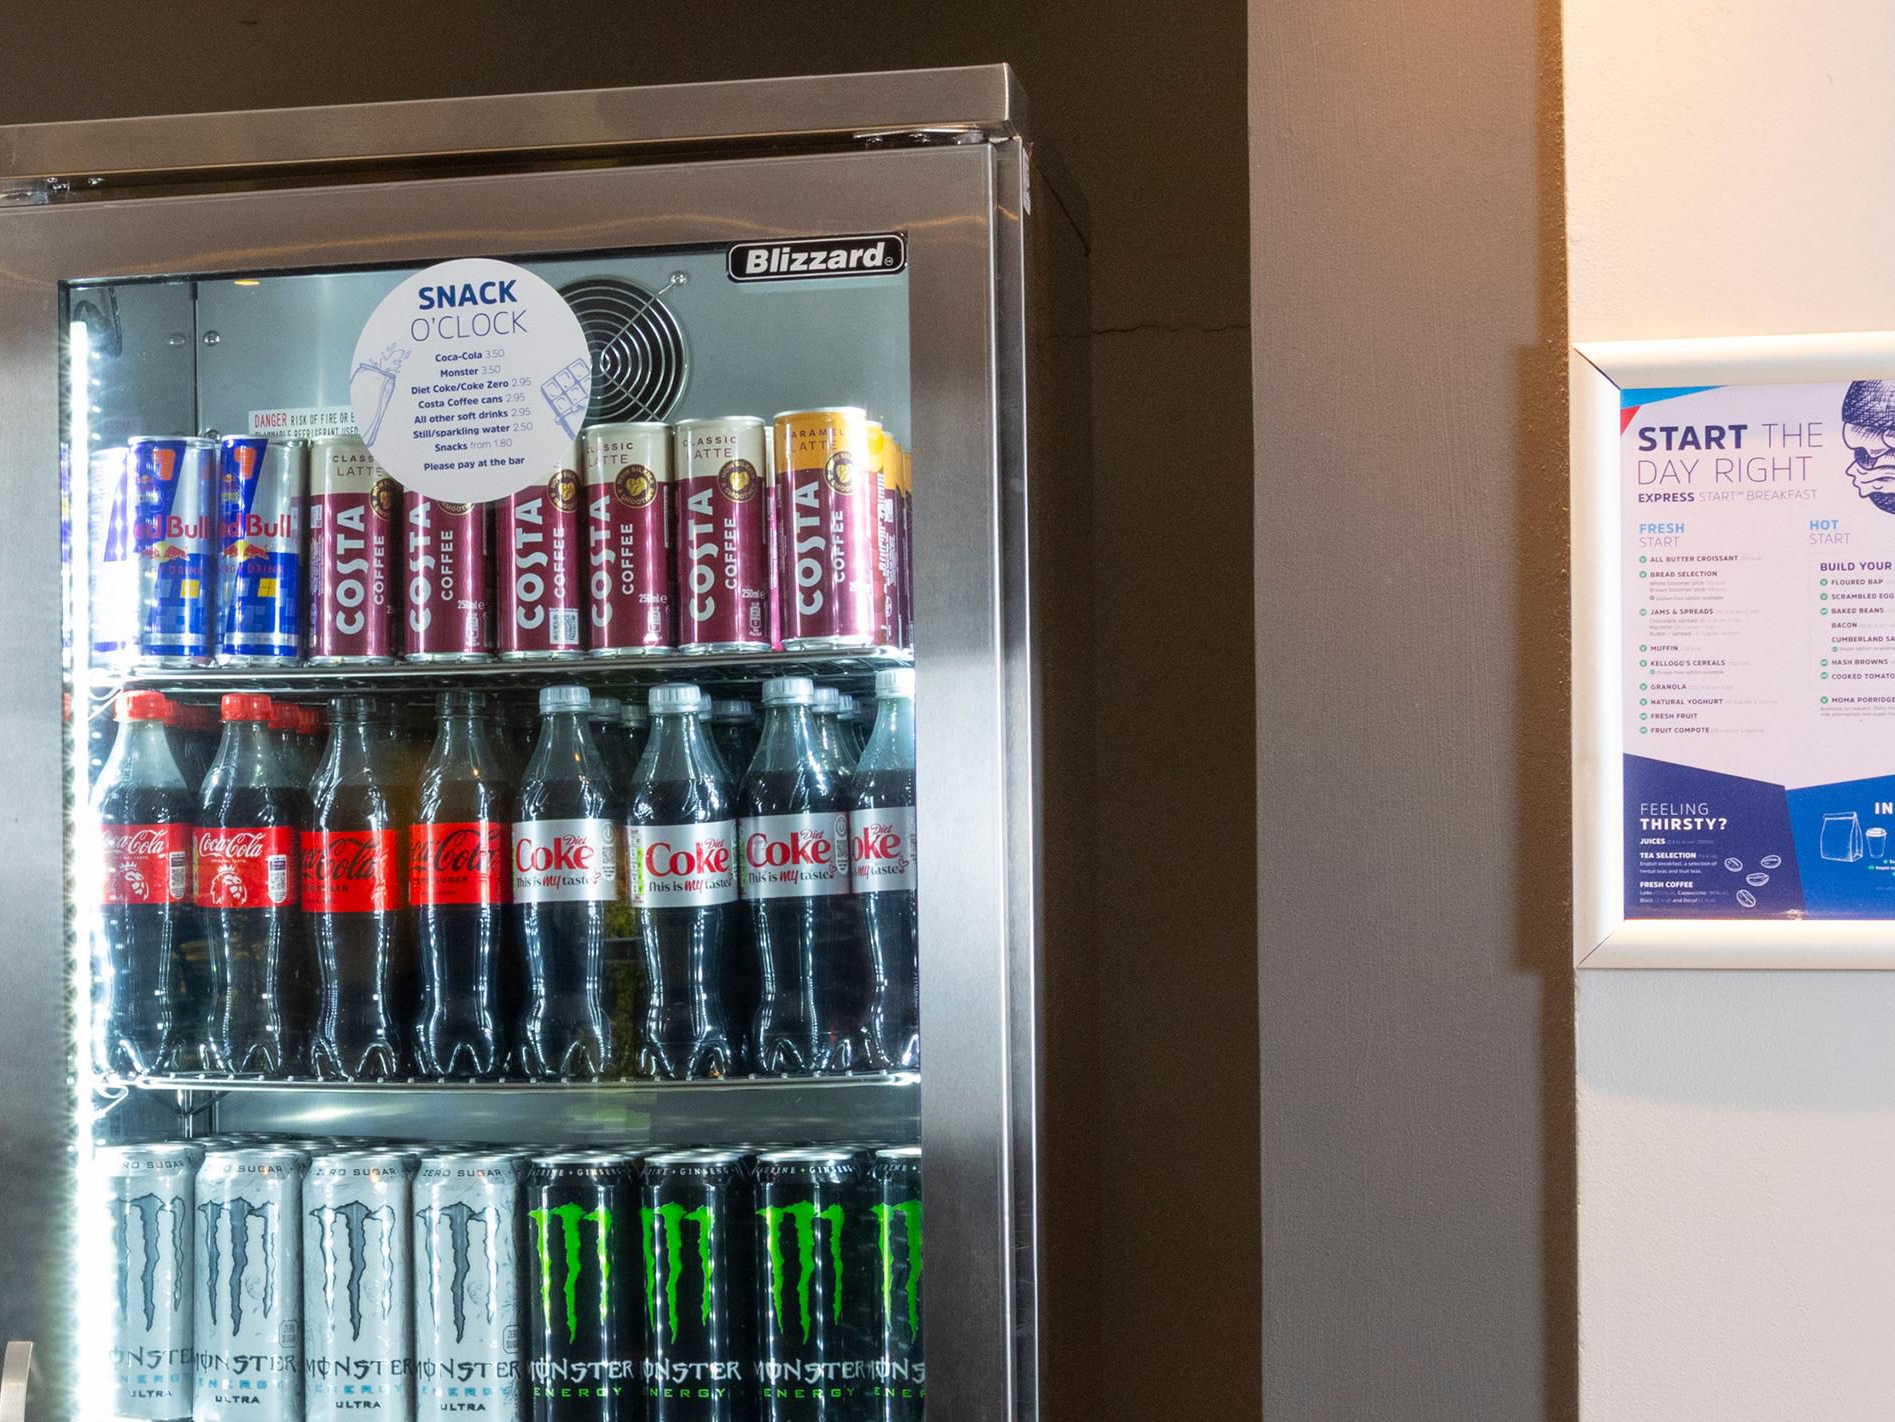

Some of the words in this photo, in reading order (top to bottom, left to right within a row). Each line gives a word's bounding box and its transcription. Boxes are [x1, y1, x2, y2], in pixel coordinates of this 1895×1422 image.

[745, 242, 885, 275] Blizzard
[418, 280, 518, 310] SNACK
[410, 310, 528, 342] O'CLOCK
[435, 351, 482, 362] Coca-Cola
[485, 349, 505, 359] 3.50
[440, 368, 478, 378] Monster
[481, 365, 501, 375] 3.50
[411, 386, 431, 395] Diet
[433, 382, 484, 393] Coke/Coke
[487, 380, 509, 389] Zero
[511, 377, 532, 387] 2.95
[418, 400, 445, 409] Costa
[447, 397, 479, 407] Coffee
[481, 396, 503, 404] cans
[505, 393, 526, 402] 2.95
[254, 413, 287, 428] DANGER
[291, 415, 307, 425] RISK
[309, 414, 318, 425] OF
[321, 413, 337, 424] FIRE
[340, 413, 349, 423] OR
[414, 415, 427, 424] All
[429, 413, 455, 423] other
[457, 411, 476, 421] soft
[478, 410, 508, 419] drinks
[511, 407, 531, 417] 2.95
[413, 427, 479, 439] Still/sparkling
[482, 424, 510, 434] water
[513, 422, 533, 432] 2.50
[1638, 425, 1748, 451] START
[1761, 422, 1823, 448] THE
[435, 442, 468, 452] Snacks
[470, 440, 491, 449] from
[494, 438, 513, 447] 1.80
[424, 462, 455, 471] Please
[458, 460, 475, 472] pay
[478, 459, 487, 467] at
[490, 457, 506, 466] the
[508, 456, 525, 465] bar
[1638, 459, 1699, 485] DAY
[1715, 456, 1813, 483] RIGHT
[1638, 492, 1695, 503] EXPRESS
[1746, 489, 1817, 501] BREAKFAST
[166, 515, 210, 539] Bull
[246, 514, 292, 538] Bull
[1639, 523, 1685, 534] FRESH
[1809, 520, 1839, 530] HOT
[832, 510, 845, 583] COFFEE
[1639, 536, 1680, 548] START
[1809, 533, 1850, 545] START
[688, 488, 719, 622] COSTA
[725, 517, 737, 589] COFFEE
[794, 481, 826, 616] COSTA
[409, 501, 436, 633] COSTA
[441, 530, 453, 600] COFFEE
[516, 498, 548, 629] COSTA
[554, 528, 566, 598] COFFEE
[589, 495, 616, 628] COSTA
[620, 523, 634, 595] COFFEE
[1820, 562, 1855, 571] BUILD
[1860, 561, 1892, 570] YOUR
[335, 505, 369, 635] COSTA
[373, 535, 385, 605] COFFEE
[1640, 803, 1709, 816] FEELING
[1874, 802, 1893, 815] IN
[870, 823, 893, 835] Diet
[1640, 818, 1727, 830] THIRSTY?
[563, 834, 587, 845] Diet
[800, 829, 825, 840] Diet
[200, 832, 266, 858] Coca-Cola
[705, 838, 724, 849] Diet
[746, 832, 832, 867] Coke
[515, 838, 594, 873] Coke
[645, 842, 730, 877] Coke
[870, 864, 899, 875] taste
[237, 1164, 283, 1173] SUGAR
[353, 1167, 396, 1176] SUGAR
[457, 1168, 502, 1177] SUGAR
[754, 1358, 867, 1385] MONSTER
[534, 1388, 622, 1397] ENERGY
[763, 1387, 855, 1398] ENERGY
[336, 1401, 381, 1409] ULTRA
[440, 1402, 486, 1411] ULTRA
